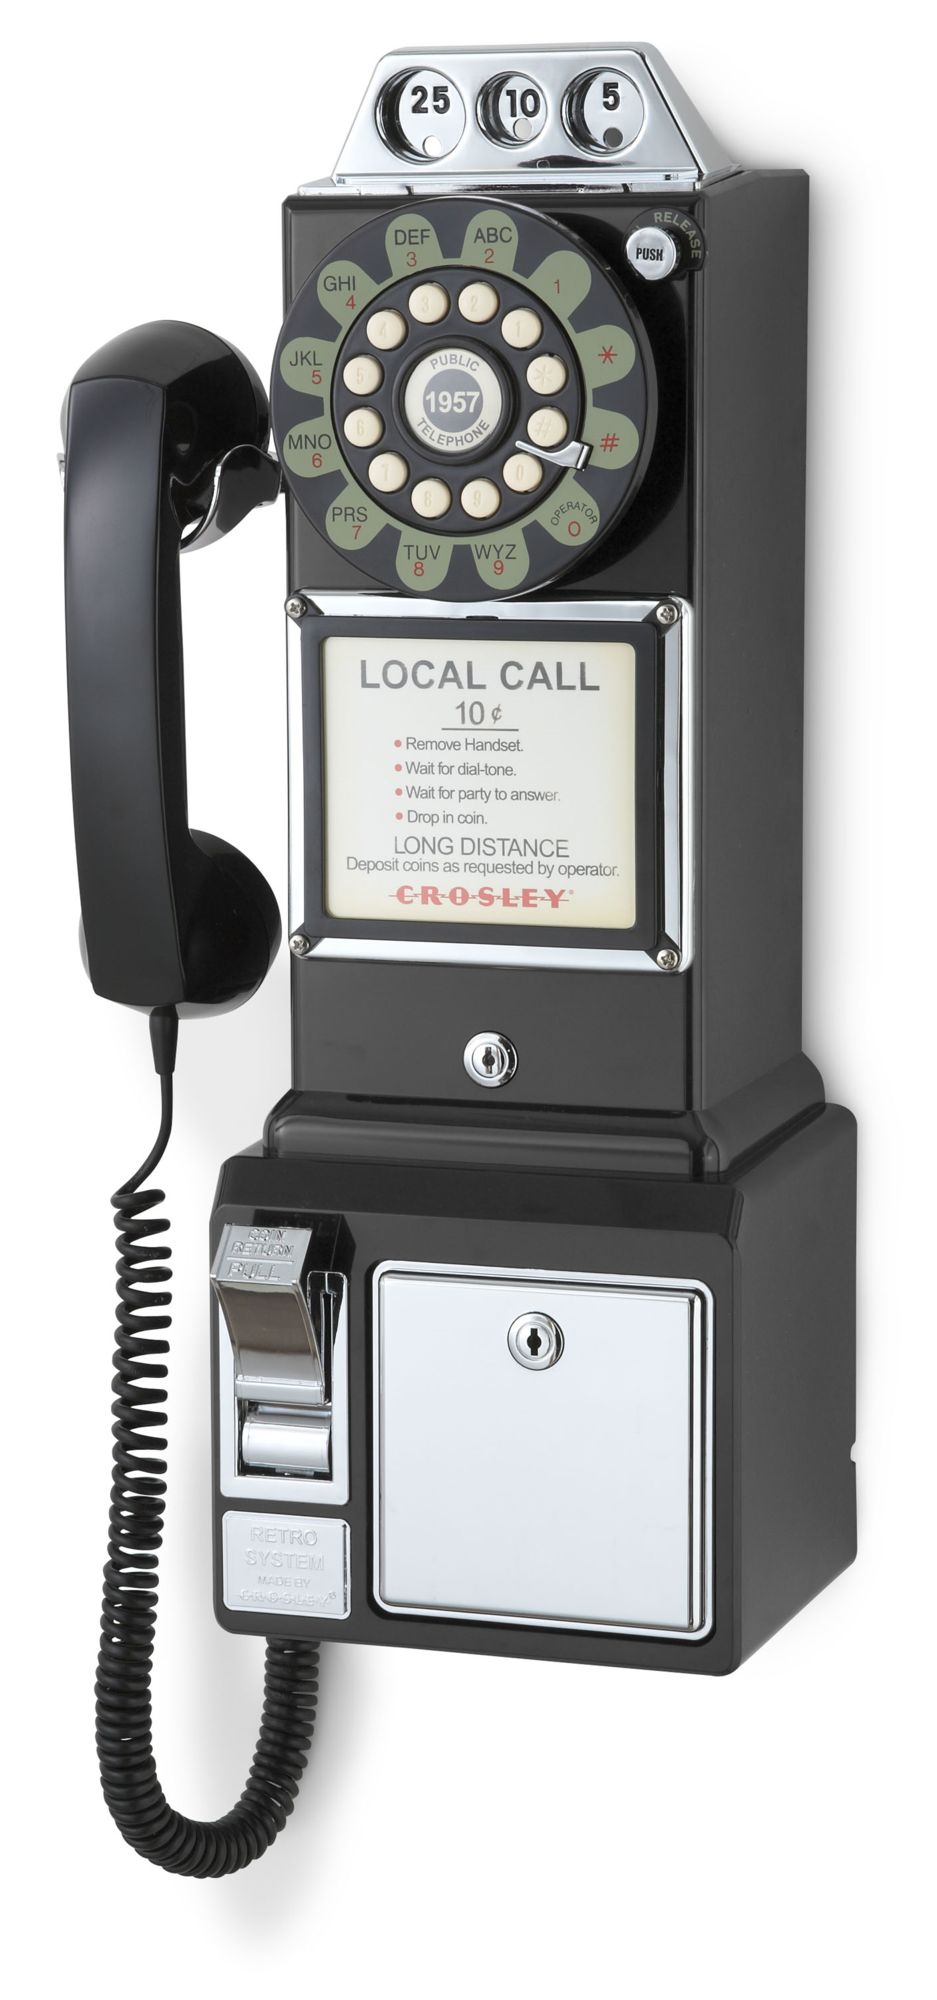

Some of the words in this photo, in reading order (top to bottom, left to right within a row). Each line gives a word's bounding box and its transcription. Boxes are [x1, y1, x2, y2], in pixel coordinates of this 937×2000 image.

[411, 85, 450, 114] 25
[506, 88, 540, 118] 10
[602, 82, 620, 111] 5
[394, 228, 431, 246] DEF
[473, 227, 513, 244] ABC
[654, 211, 701, 259] RELEASE
[406, 251, 417, 267] 3
[484, 248, 495, 264] 2
[636, 247, 663, 261] PUSH
[323, 275, 356, 292] GHI
[553, 279, 561, 294] 1
[345, 296, 356, 310] 4
[289, 350, 323, 367] JKL
[430, 354, 480, 372] PUBLIC
[311, 370, 322, 385] 5
[425, 390, 480, 413] 1957
[417, 417, 490, 447] TELEPHONE
[288, 433, 332, 450] MNO
[311, 453, 323, 469] 6
[332, 507, 368, 522] PRS
[550, 500, 598, 527] OPERATOR
[351, 525, 362, 540] 7
[403, 544, 441, 561] TUV
[475, 543, 517, 560] WYZ
[413, 561, 424, 577] 8
[493, 559, 504, 575] 9
[360, 659, 487, 690] LOCAL
[500, 661, 600, 691] CALL
[455, 701, 485, 725] 10
[405, 737, 461, 751] Remove
[465, 738, 523, 752] Handset.
[405, 761, 435, 775] Wait
[438, 761, 454, 775] for
[457, 762, 517, 776] dial-tone.
[406, 786, 435, 800] Wait
[438, 786, 455, 800] for
[458, 787, 491, 804] party
[494, 788, 507, 801] to
[511, 790, 560, 802] answer.
[407, 810, 440, 826] Drop
[443, 811, 454, 824] in
[457, 811, 488, 824] coin.
[394, 836, 453, 855] LONG
[460, 837, 570, 858] DISTANCE
[346, 856, 400, 875] Deposit
[403, 857, 439, 872] coins
[443, 861, 460, 873] as
[463, 860, 533, 876] requested
[537, 861, 554, 877] by
[558, 862, 620, 878] operator.
[394, 885, 568, 909] CROSLEY
[231, 1241, 294, 1257] RETURN
[227, 1262, 280, 1281] PULL
[250, 1526, 318, 1546] RETRO
[245, 1548, 325, 1571] SYSTEM
[258, 1576, 292, 1587] MADE
[294, 1577, 311, 1588] BY
